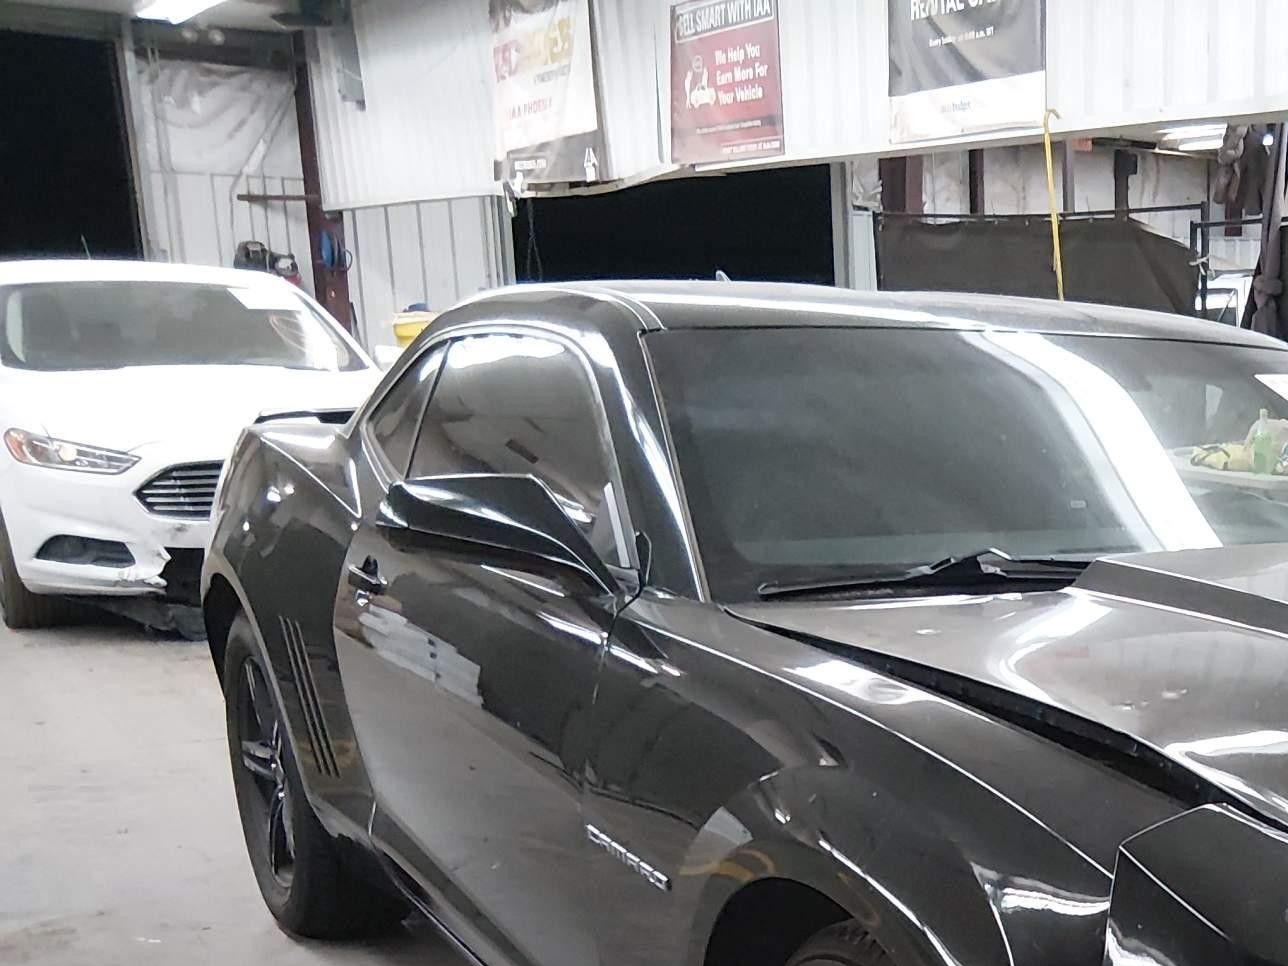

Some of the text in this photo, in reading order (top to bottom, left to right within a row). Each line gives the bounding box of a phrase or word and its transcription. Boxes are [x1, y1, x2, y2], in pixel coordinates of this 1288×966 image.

[696, 4, 725, 32] SMART
[727, 0, 751, 24] WITH
[715, 50, 727, 65] We
[727, 45, 744, 63] Help
[745, 43, 760, 58] You
[717, 62, 768, 85] Earn More For
[718, 83, 763, 106] Your Vehicle
